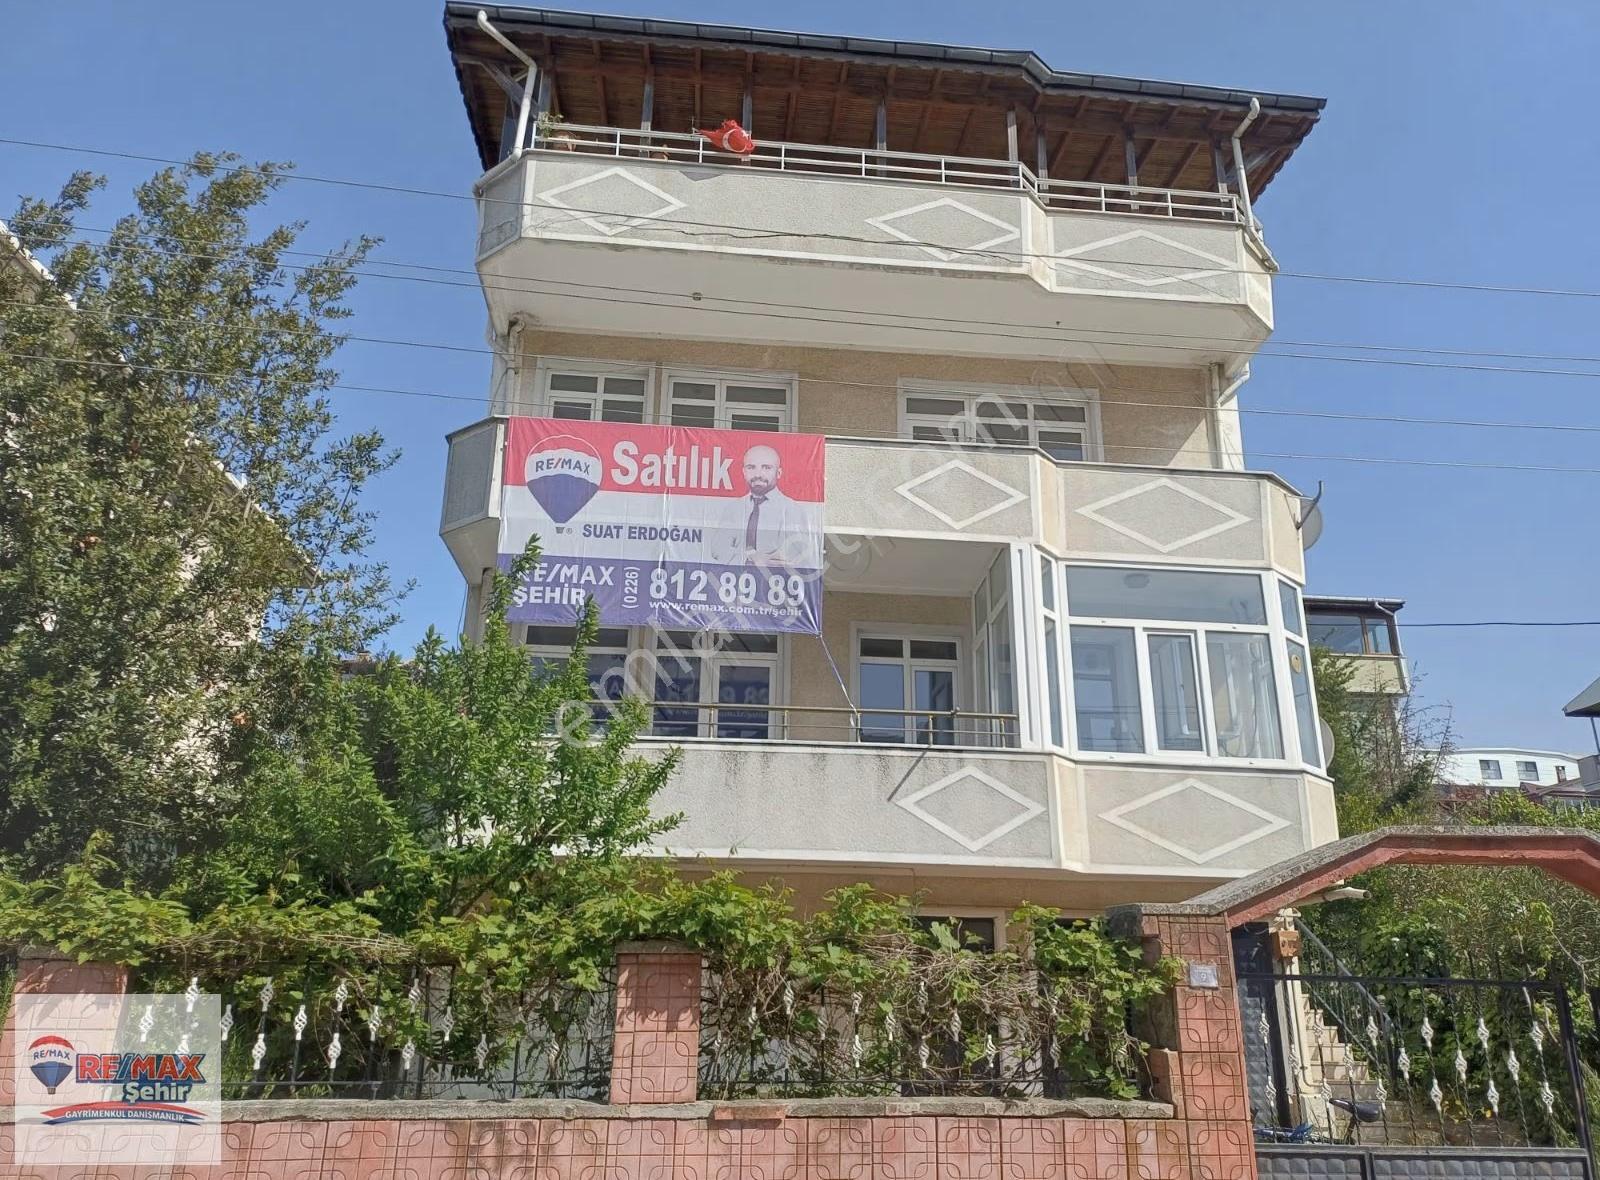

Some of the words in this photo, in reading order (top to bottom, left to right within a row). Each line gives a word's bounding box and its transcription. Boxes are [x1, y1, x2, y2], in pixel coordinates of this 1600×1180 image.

[535, 457, 590, 475] RE/MAX
[610, 440, 734, 490] Satılık
[583, 524, 623, 539] SUAT
[627, 525, 702, 543] ERDOĞAN
[649, 568, 707, 601] 812
[718, 571, 757, 604] 89
[767, 574, 805, 607] 89
